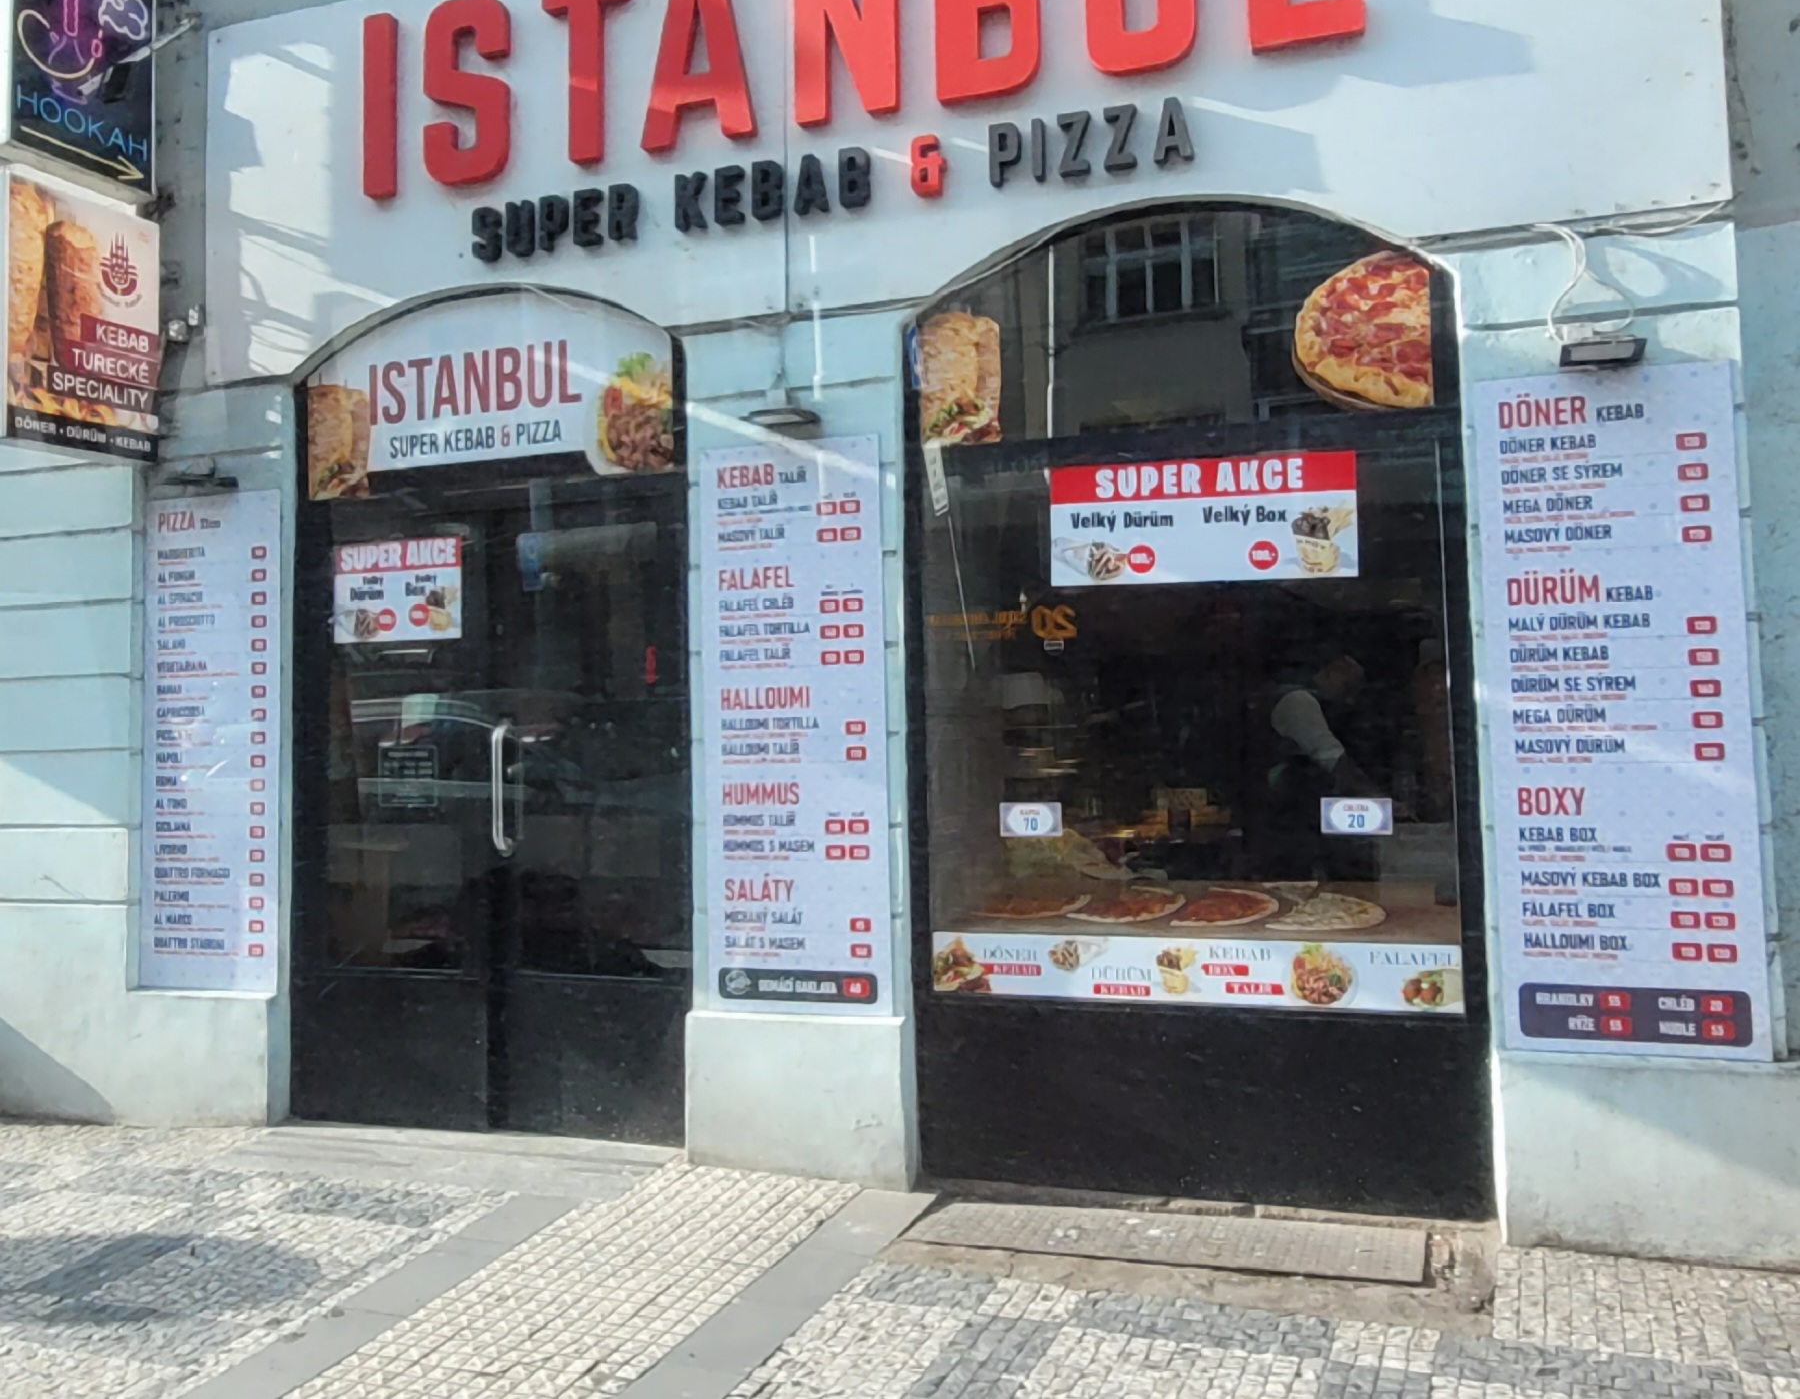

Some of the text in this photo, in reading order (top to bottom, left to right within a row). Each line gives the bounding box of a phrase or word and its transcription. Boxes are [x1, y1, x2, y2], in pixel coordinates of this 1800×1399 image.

[16, 84, 148, 161] HOOKAH
[471, 96, 1195, 262] SUPER KEBAB & PIZZA
[96, 324, 149, 352] KEBAB
[71, 347, 150, 384] TURECKÉ
[52, 372, 149, 410] SPECIALITY
[368, 339, 583, 426] ISTANBUL
[1498, 393, 1644, 429] DÖNER KEBAB
[115, 436, 151, 453] KEBAB
[390, 419, 562, 459] SUPER KEBAB & PIZZA
[1499, 434, 1596, 454] DÖNER KEBAB
[717, 463, 774, 489] KEBAB
[1095, 458, 1303, 498] SUPER AKCE
[1501, 460, 1623, 485] DÖNER SE SÝREM
[1202, 503, 1287, 526] Velký Box
[1503, 493, 1593, 515] MEGA DÖNER
[158, 510, 196, 533] PIZZA
[1070, 510, 1174, 532] Velký Dürüm
[1504, 522, 1612, 544] MASOVÝ DÖNER
[341, 538, 456, 571] SUPER AKCE
[719, 565, 795, 591] FALAFEL
[1507, 568, 1654, 606] DÜRÜM KEBAB
[763, 622, 811, 635] TORTILLA
[1508, 611, 1650, 632] MALÝ DÜRÜM KEBAB
[1510, 643, 1609, 663] DÜRÜM KEBAB
[1511, 672, 1636, 693] DÜRÜM SE SÝREM
[721, 685, 810, 711] HALLOUMI
[772, 717, 820, 730] TORTILLA
[1512, 704, 1606, 724] MEGA DÜRÜM
[1515, 735, 1625, 754] MASOVÝ DÜRÜM
[722, 782, 800, 806] HUMMUS
[1517, 787, 1585, 816] BOXY
[1023, 816, 1039, 832] 70
[1347, 814, 1365, 829] 20
[1519, 827, 1598, 842] KEBAB BOX
[724, 873, 795, 902] SALÁTY
[1521, 867, 1661, 888] MASOVÝ KEBAB BOX
[1522, 902, 1615, 918] FALAFEL BOX
[1523, 932, 1628, 950] HALLOUMI BOX
[1208, 946, 1271, 962] KEBAB
[1369, 951, 1460, 967] FALAFEL
